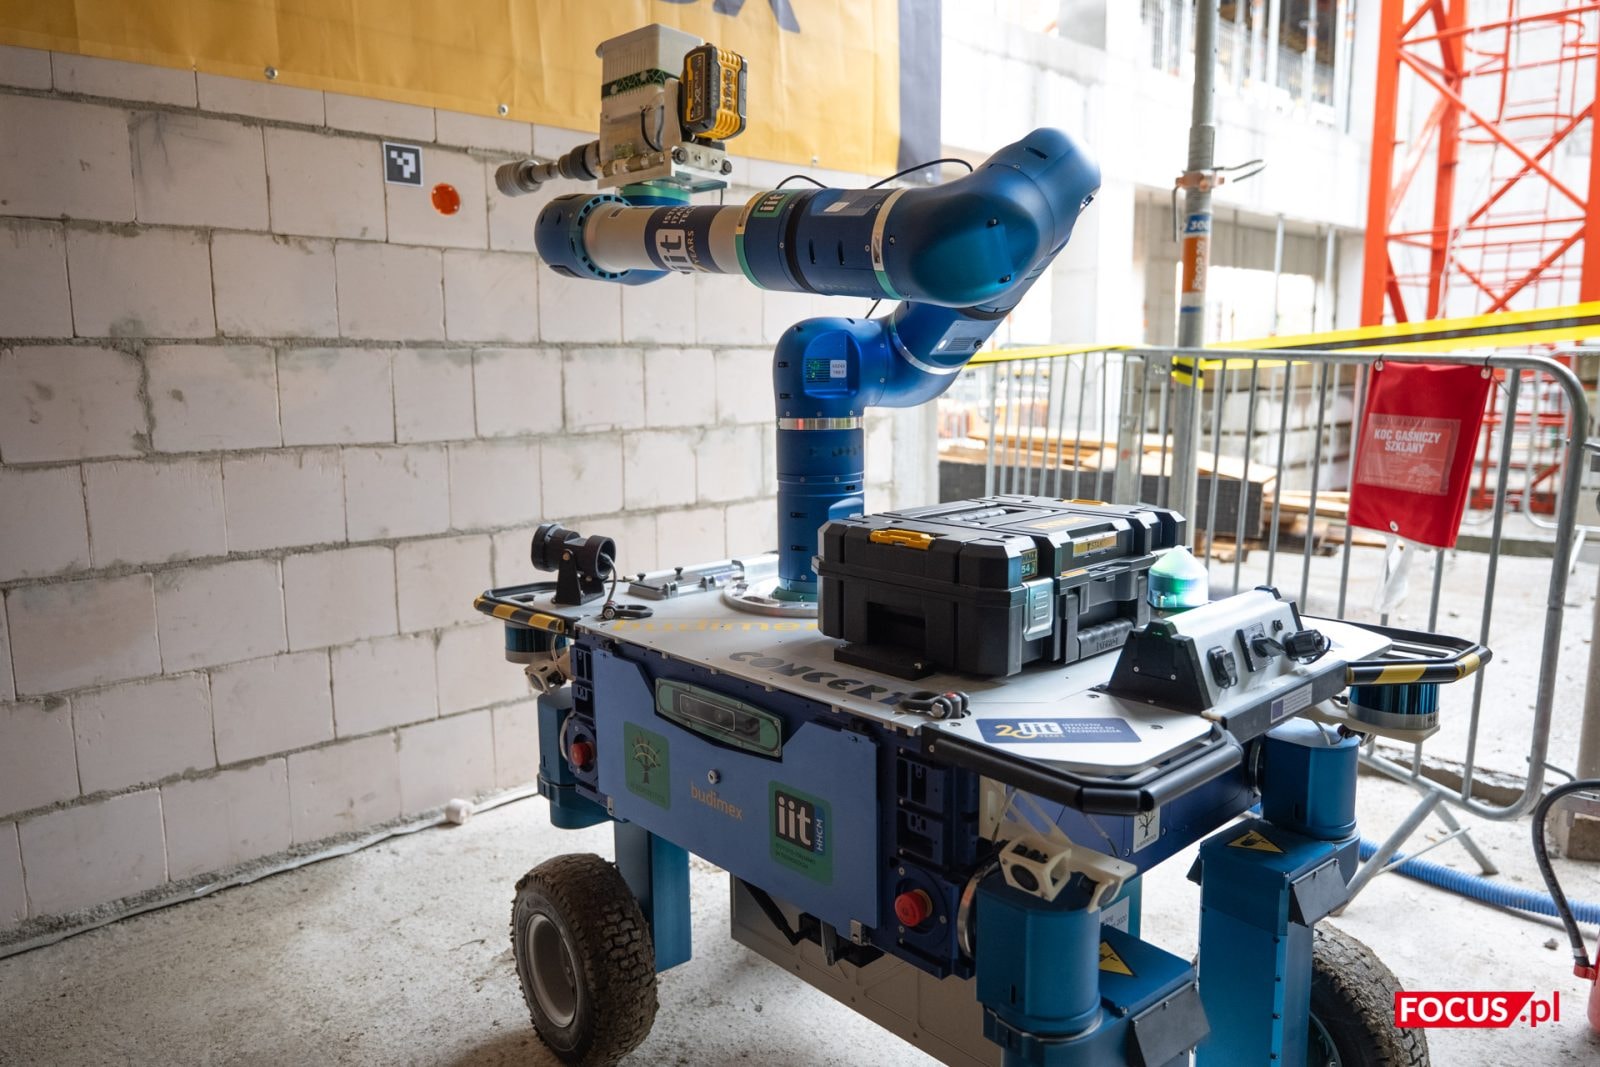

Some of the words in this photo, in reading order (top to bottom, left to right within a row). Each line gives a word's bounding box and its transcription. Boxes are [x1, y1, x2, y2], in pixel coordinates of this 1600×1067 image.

[1374, 428, 1393, 440] KOC
[1395, 427, 1441, 444] GAŚNICZY
[1385, 440, 1425, 454] SZKLANY
[690, 782, 743, 821] budimex
[777, 796, 812, 847] iit
[816, 819, 824, 852] HHCM
